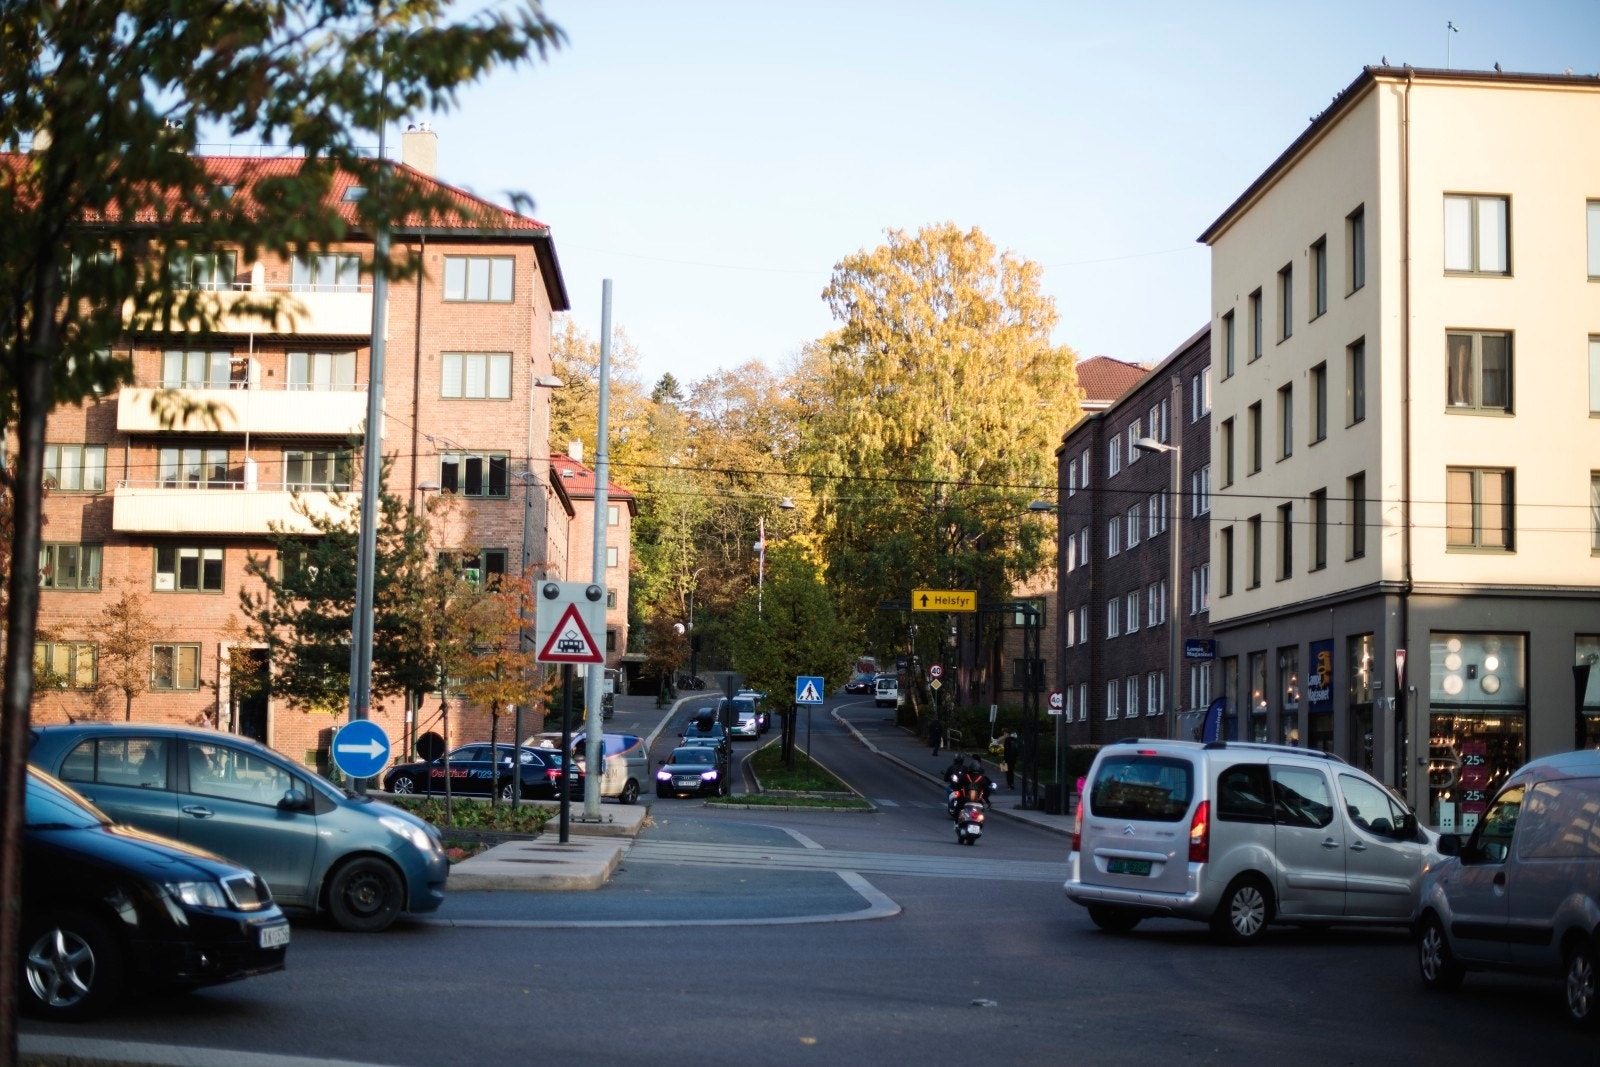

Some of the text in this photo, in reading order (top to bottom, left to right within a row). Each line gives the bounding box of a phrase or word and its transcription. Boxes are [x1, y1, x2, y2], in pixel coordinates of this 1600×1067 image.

[934, 596, 970, 606] Helsfyr
[931, 666, 941, 675] 40
[1308, 672, 1321, 687] Lampe
[1308, 687, 1330, 704] Magasinet
